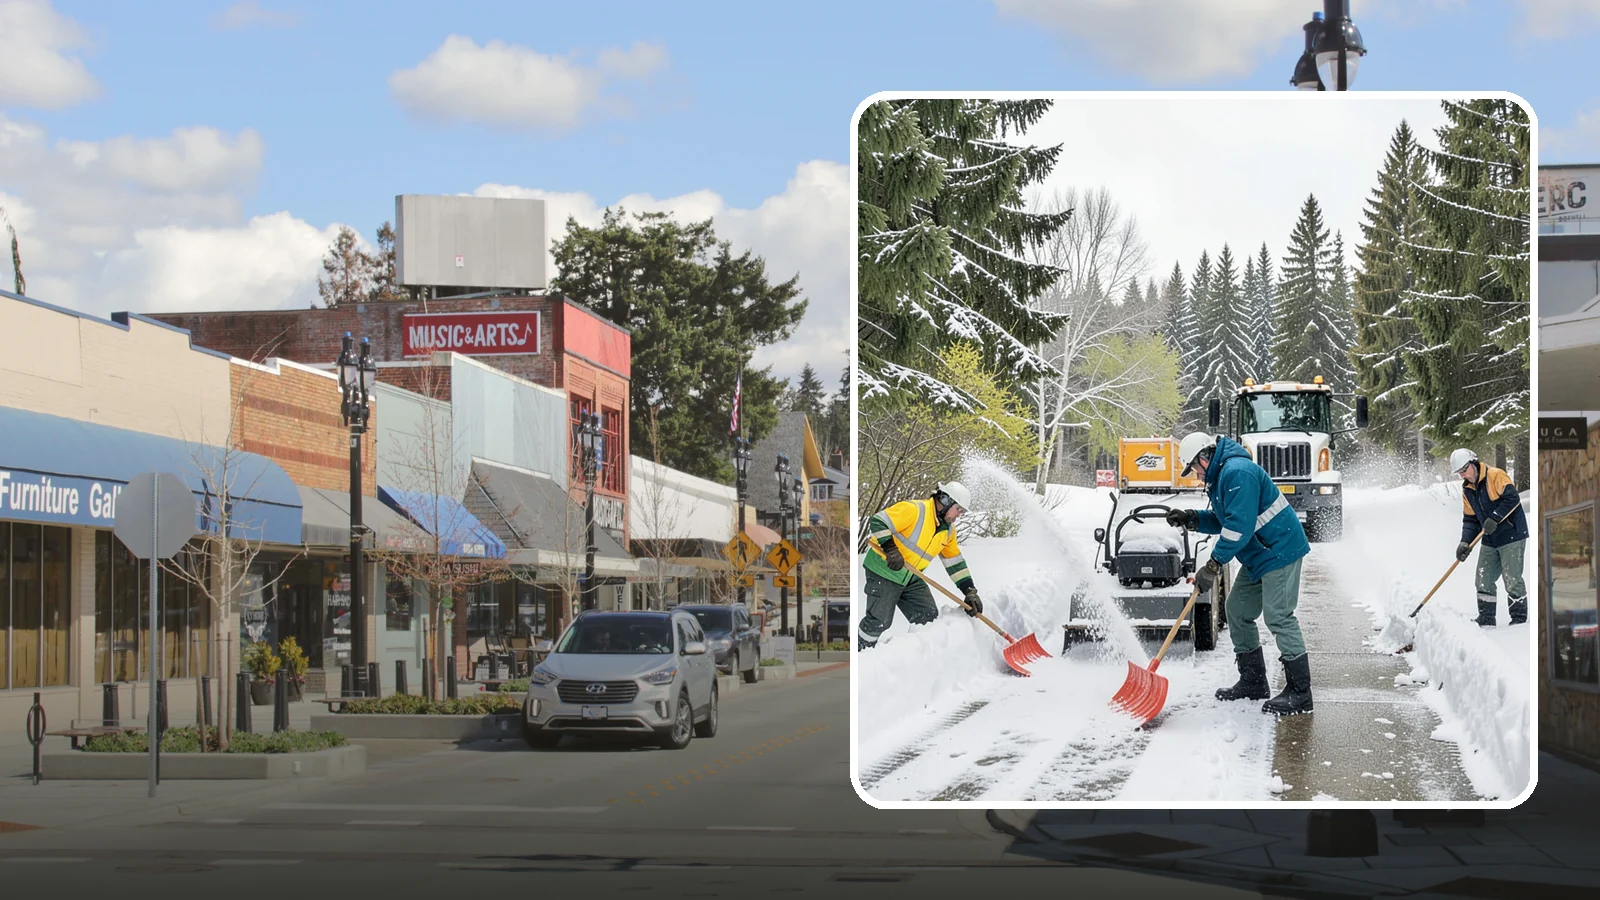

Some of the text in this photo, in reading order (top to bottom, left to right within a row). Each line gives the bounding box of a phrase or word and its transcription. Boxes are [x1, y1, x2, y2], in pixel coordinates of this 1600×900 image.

[408, 323, 520, 349] MUSIC&ARTS
[0, 471, 121, 519] Furniture Gal
[453, 563, 479, 574] SUSHI
